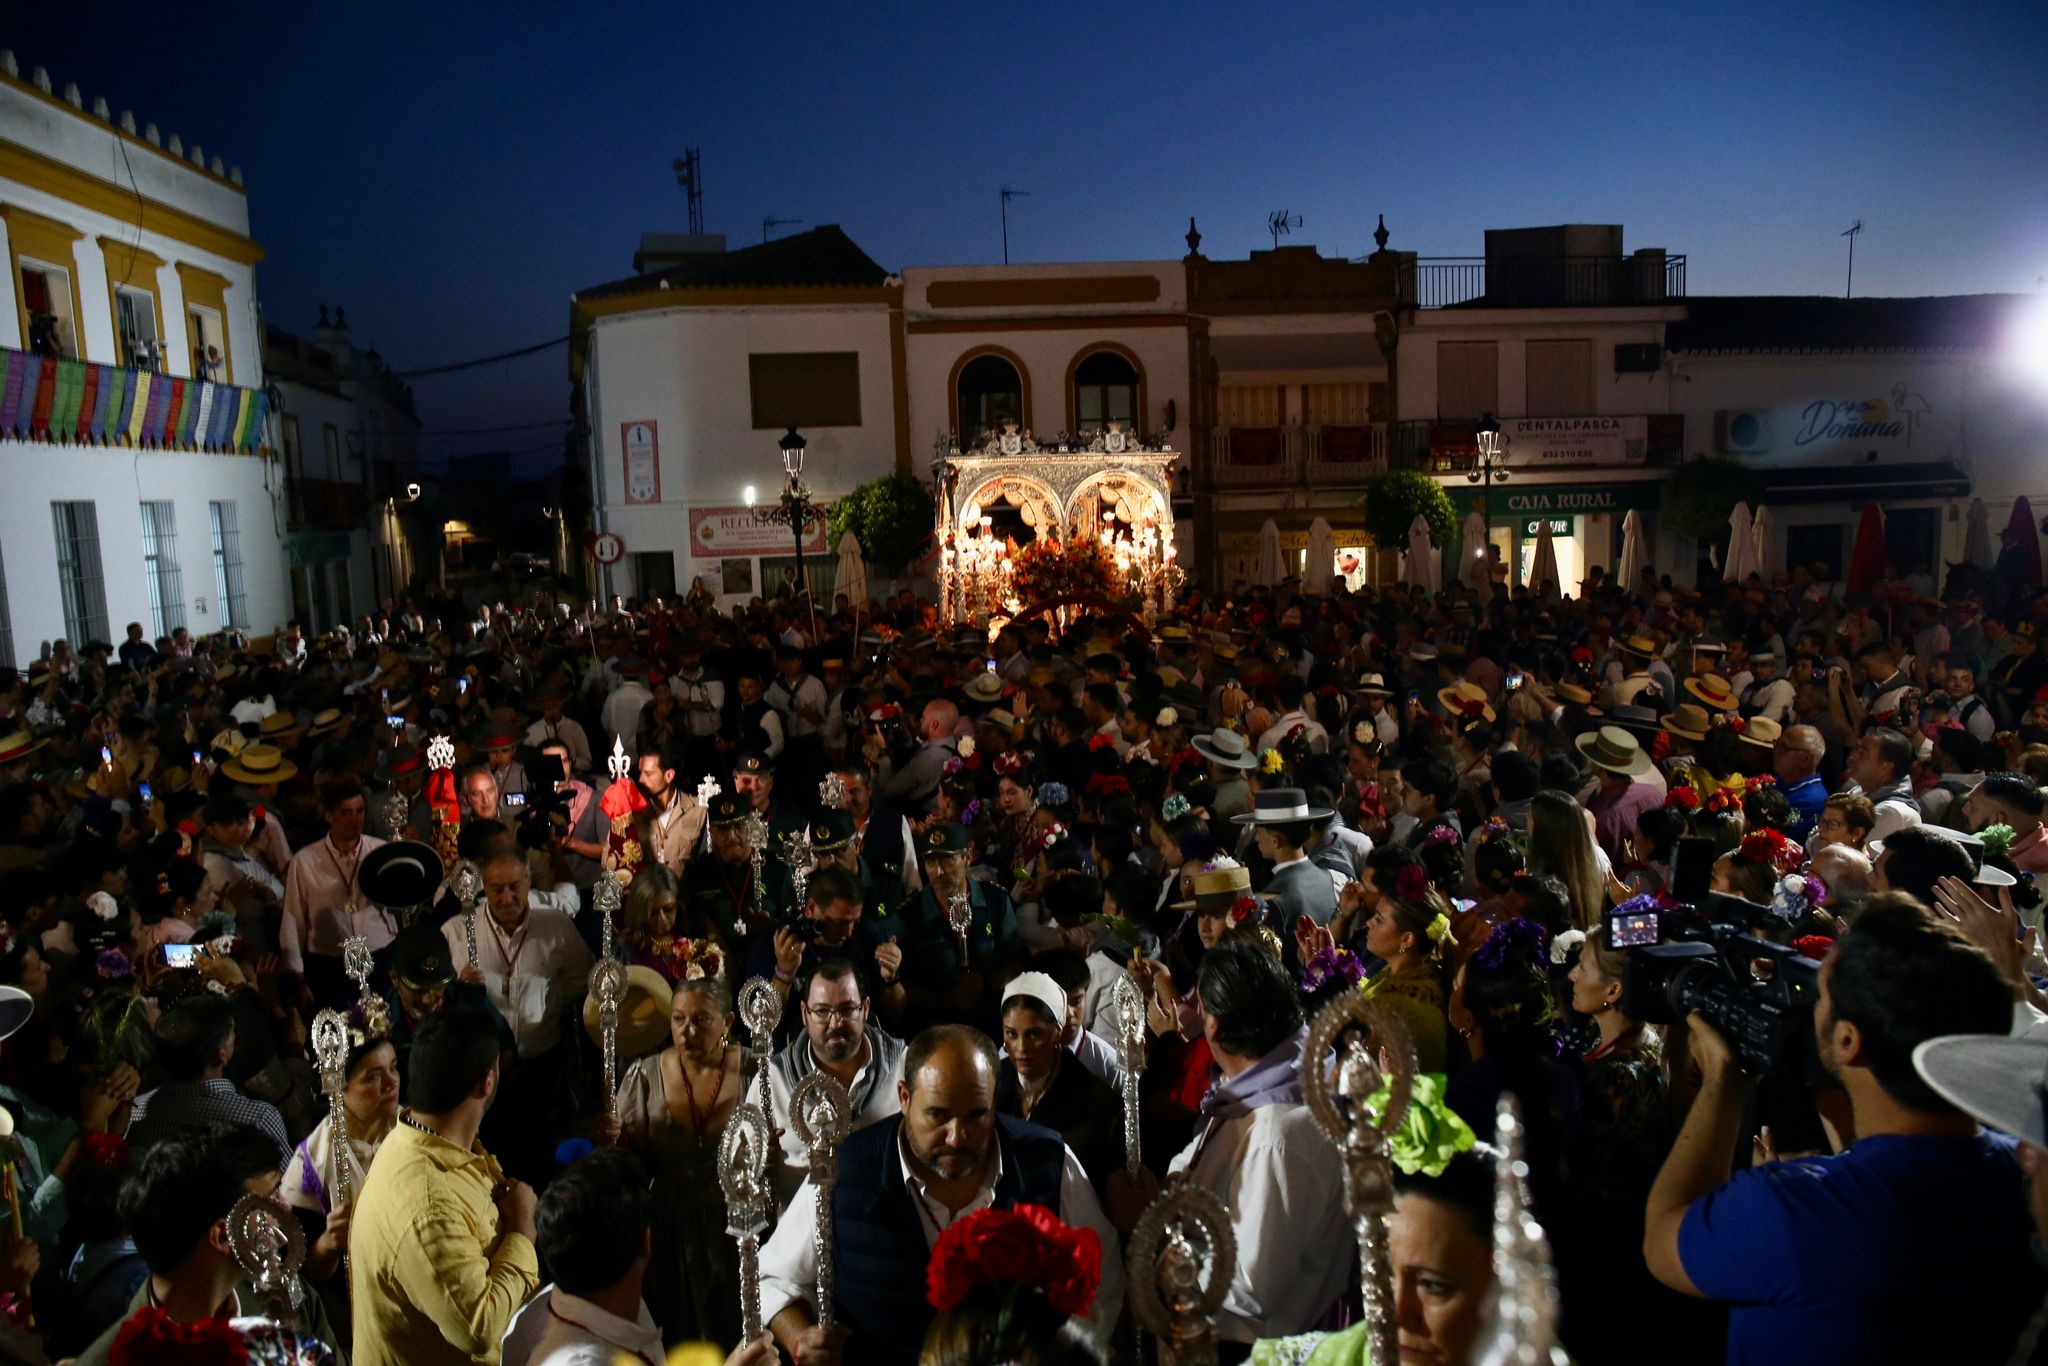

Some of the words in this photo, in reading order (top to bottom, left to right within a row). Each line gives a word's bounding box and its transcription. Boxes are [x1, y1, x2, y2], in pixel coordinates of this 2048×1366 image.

[1508, 495, 1552, 510] CAJA
[1557, 493, 1616, 508] RURAL
[721, 515, 790, 529] RECUER
